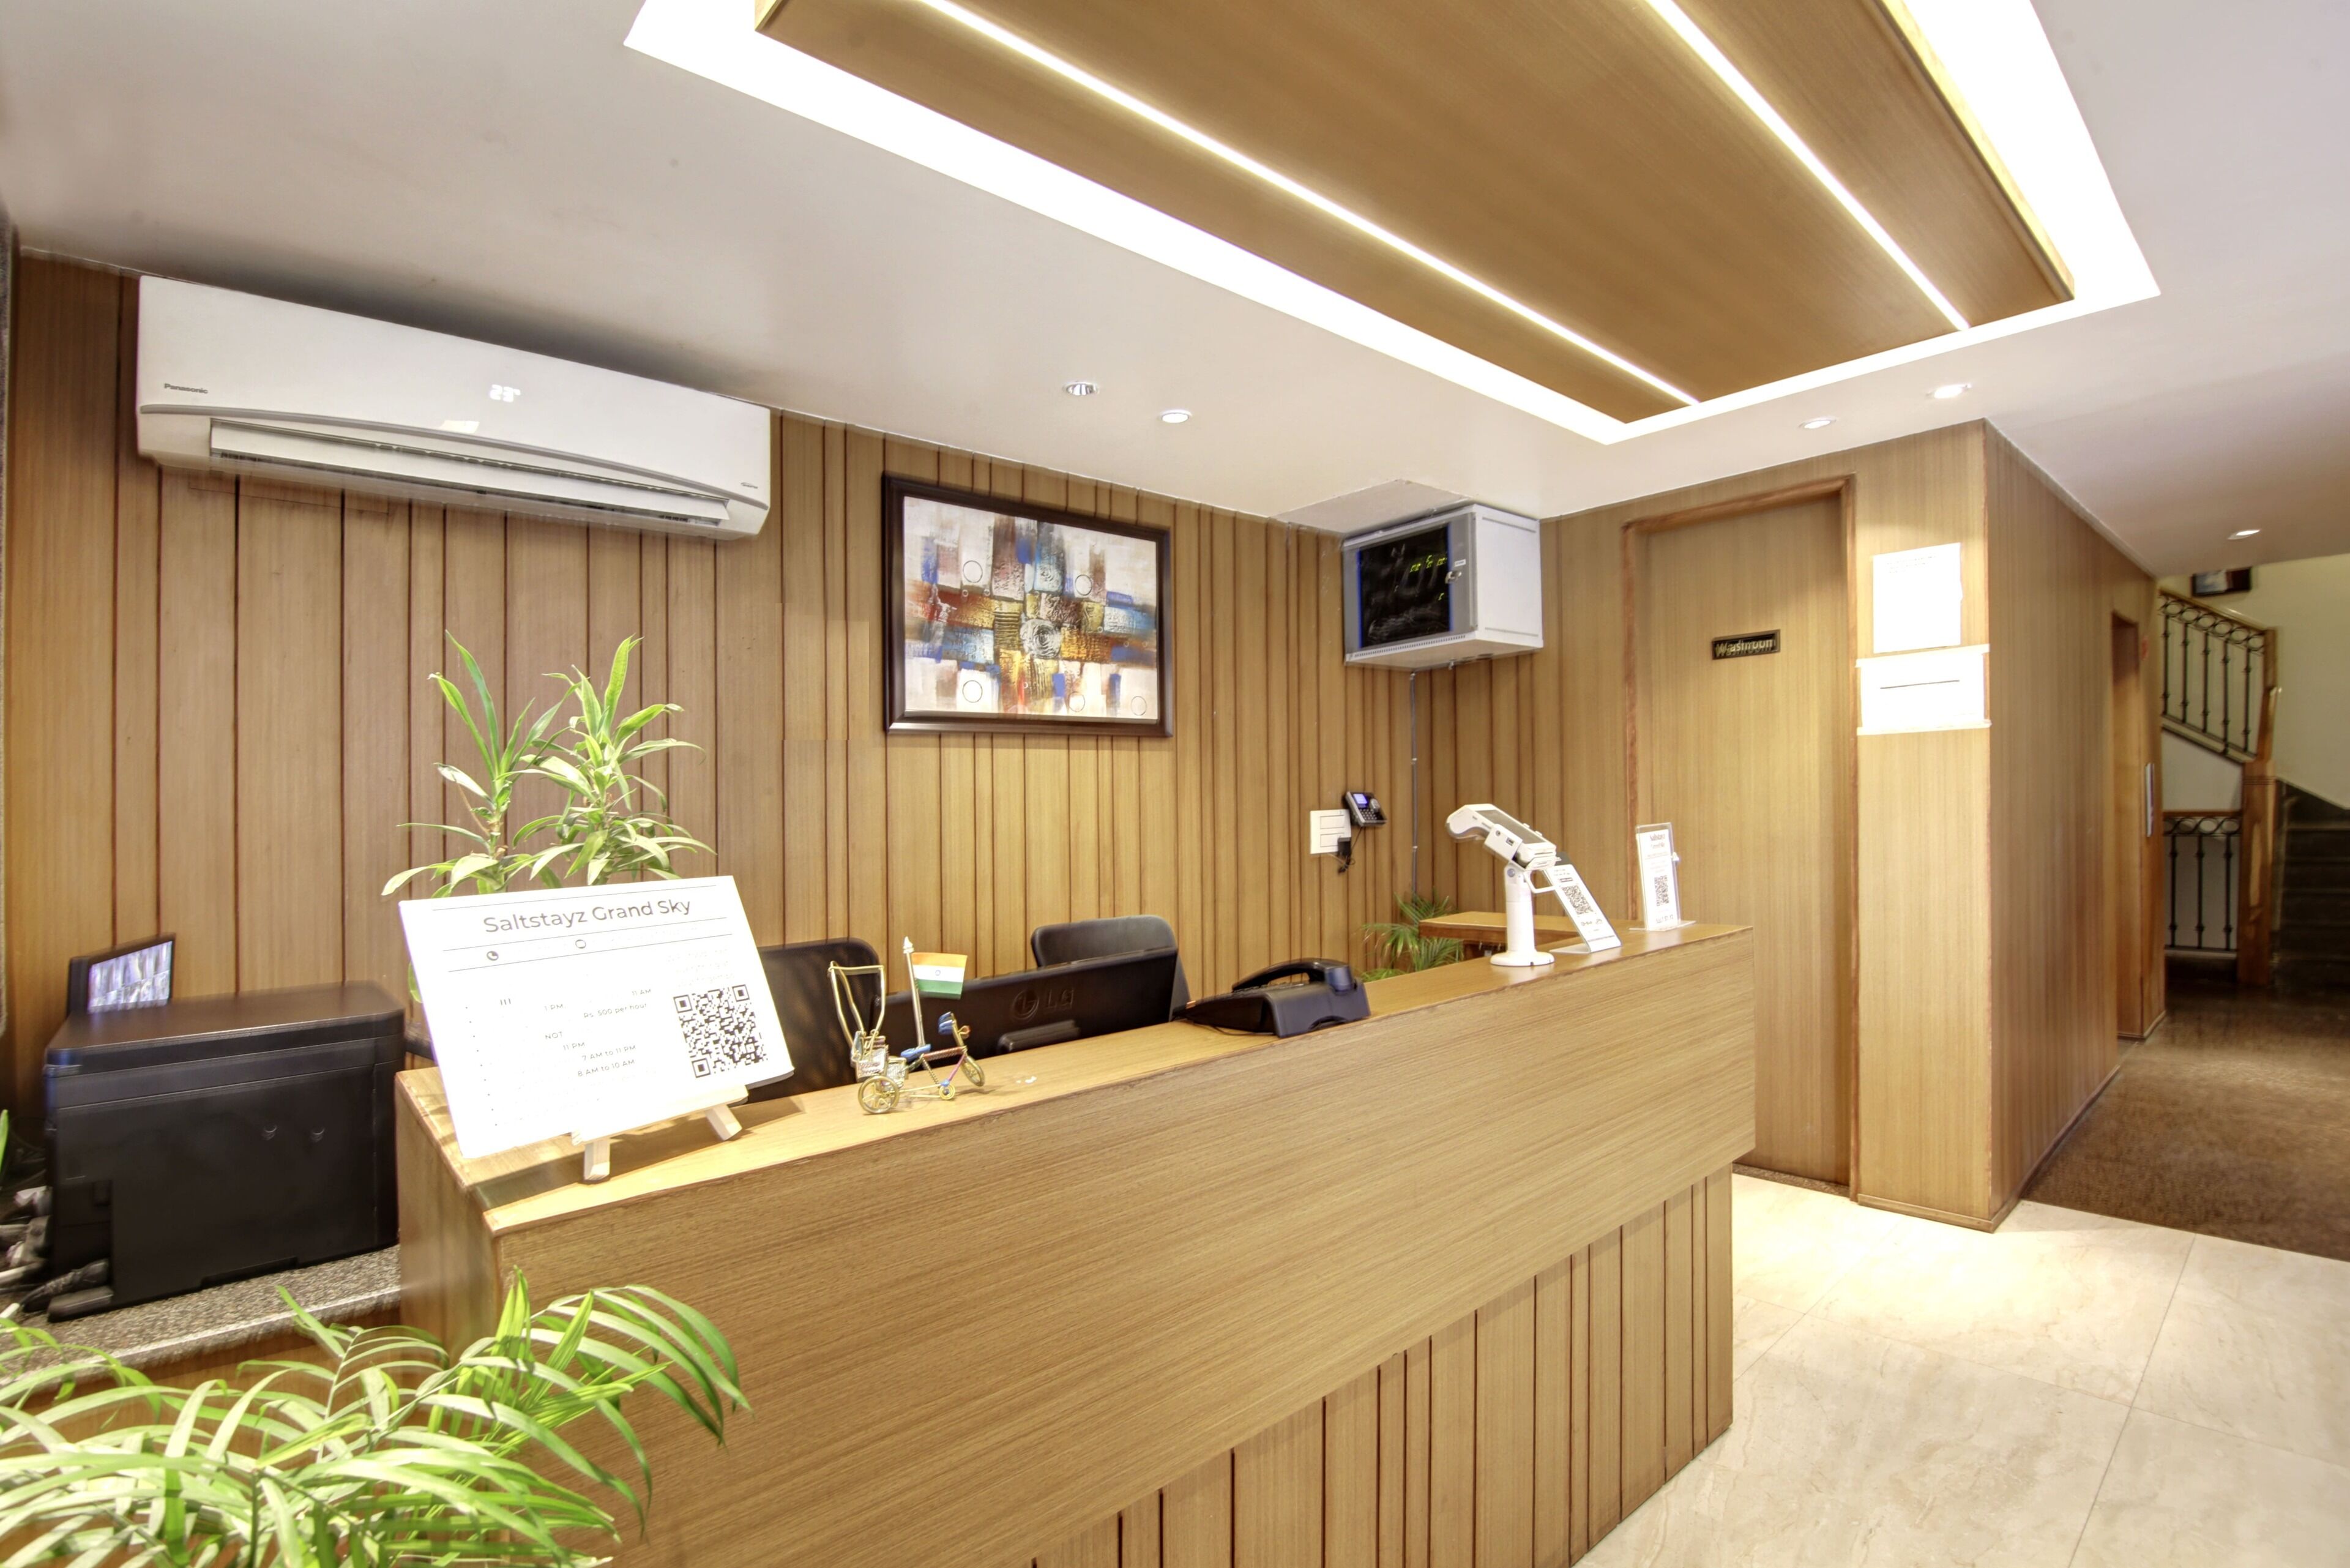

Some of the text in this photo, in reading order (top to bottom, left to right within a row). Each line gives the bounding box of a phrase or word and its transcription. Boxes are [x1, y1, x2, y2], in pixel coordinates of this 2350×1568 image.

[164, 383, 209, 394] Panasonic
[1715, 639, 1777, 654] Washroom
[483, 899, 691, 933] Saltstayz Grand Sky
[597, 1008, 613, 1017] 500
[544, 1031, 563, 1040] NOT
[585, 1067, 599, 1076] AM
